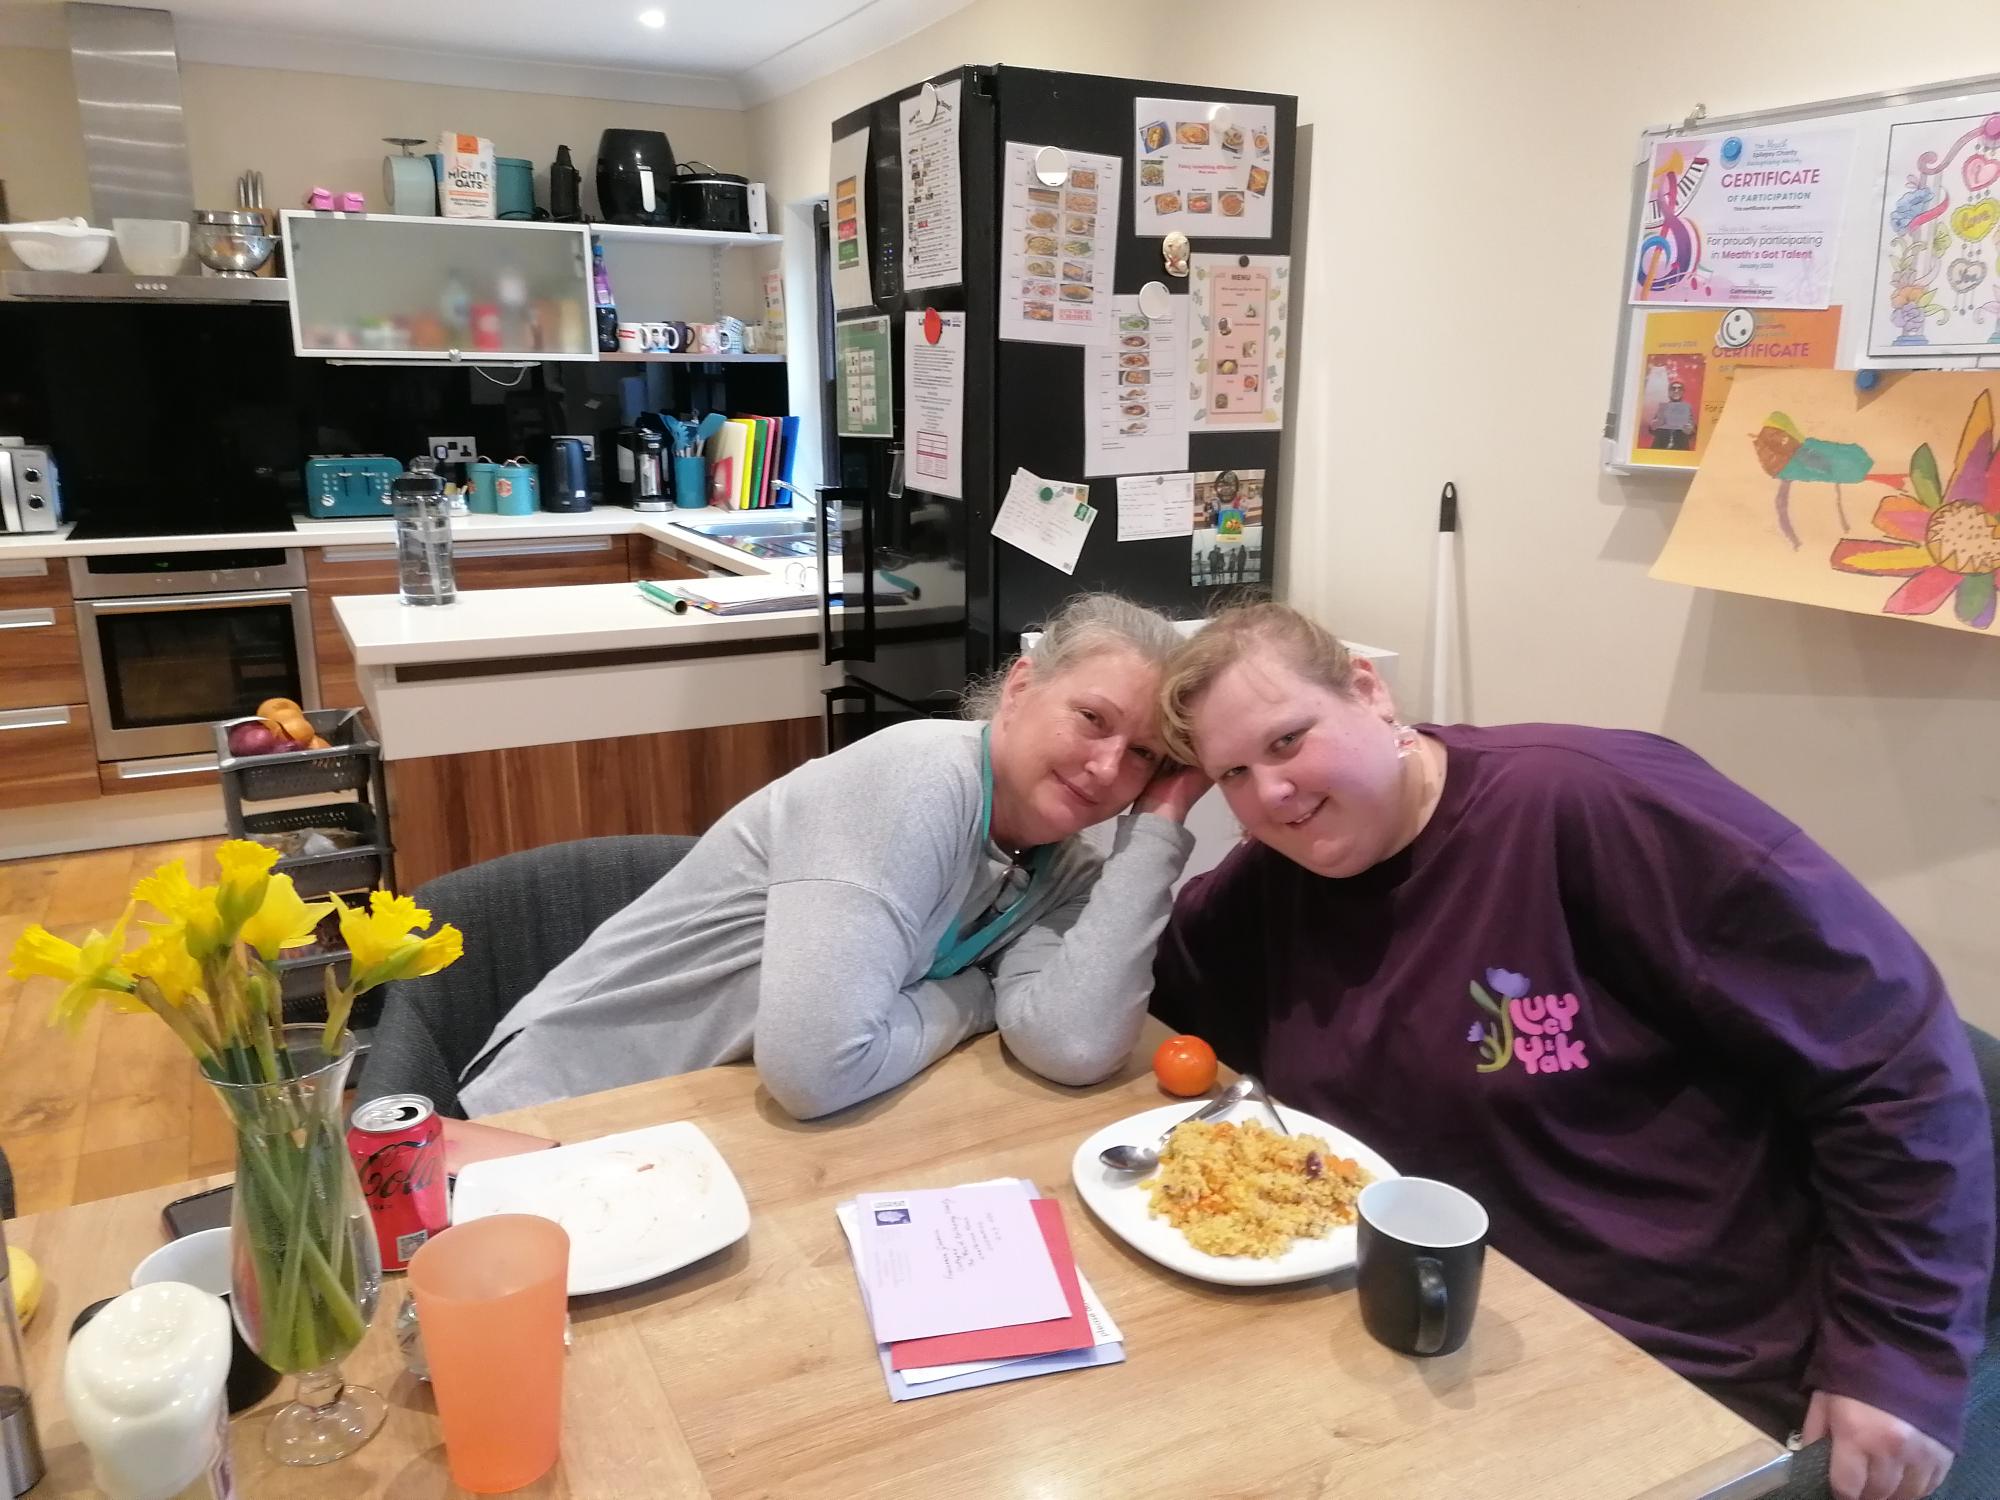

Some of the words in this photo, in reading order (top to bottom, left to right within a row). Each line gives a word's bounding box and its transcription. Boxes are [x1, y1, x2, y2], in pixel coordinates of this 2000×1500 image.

[448, 167, 488, 182] MIGHTY
[1721, 169, 1820, 188] CERTIFICATE
[455, 179, 483, 189] OATS
[1740, 192, 1811, 202] PARTICIPATION
[1707, 237, 1721, 246] For
[1722, 236, 1758, 248] proudly
[1760, 235, 1823, 247] participating
[1711, 251, 1720, 259] in
[1761, 250, 1779, 259] Got
[1782, 250, 1813, 259] Talent
[1712, 343, 1809, 358] CERTIFICATE
[1514, 1033, 1589, 1074] Yak
